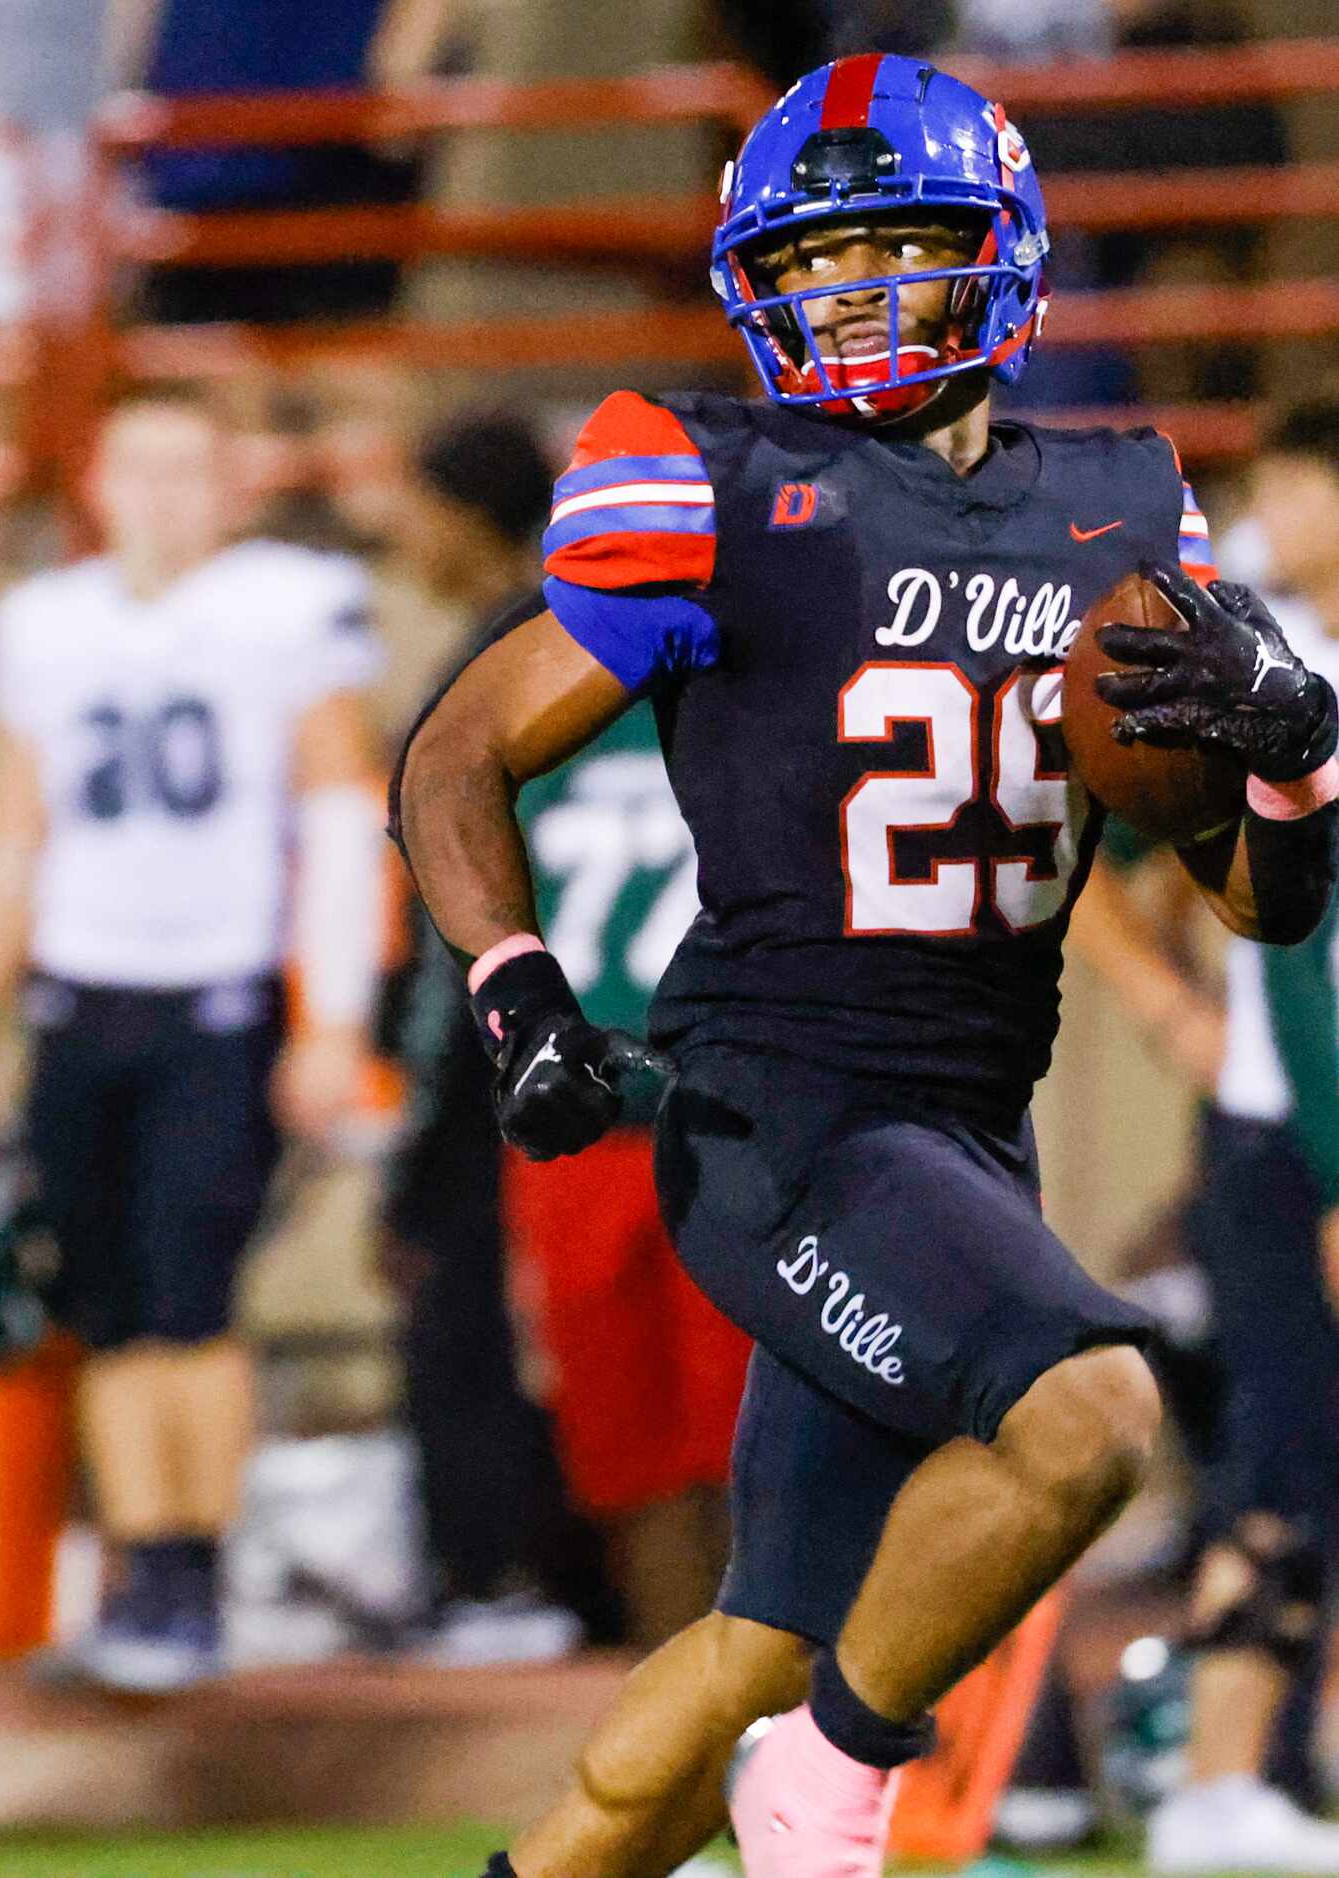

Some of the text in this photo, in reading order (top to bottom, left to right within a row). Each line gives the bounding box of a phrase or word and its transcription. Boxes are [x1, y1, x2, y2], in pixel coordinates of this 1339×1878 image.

[765, 480, 822, 532] D
[874, 567, 1082, 658] D'Ville
[775, 1235, 905, 1385] D'Ville
